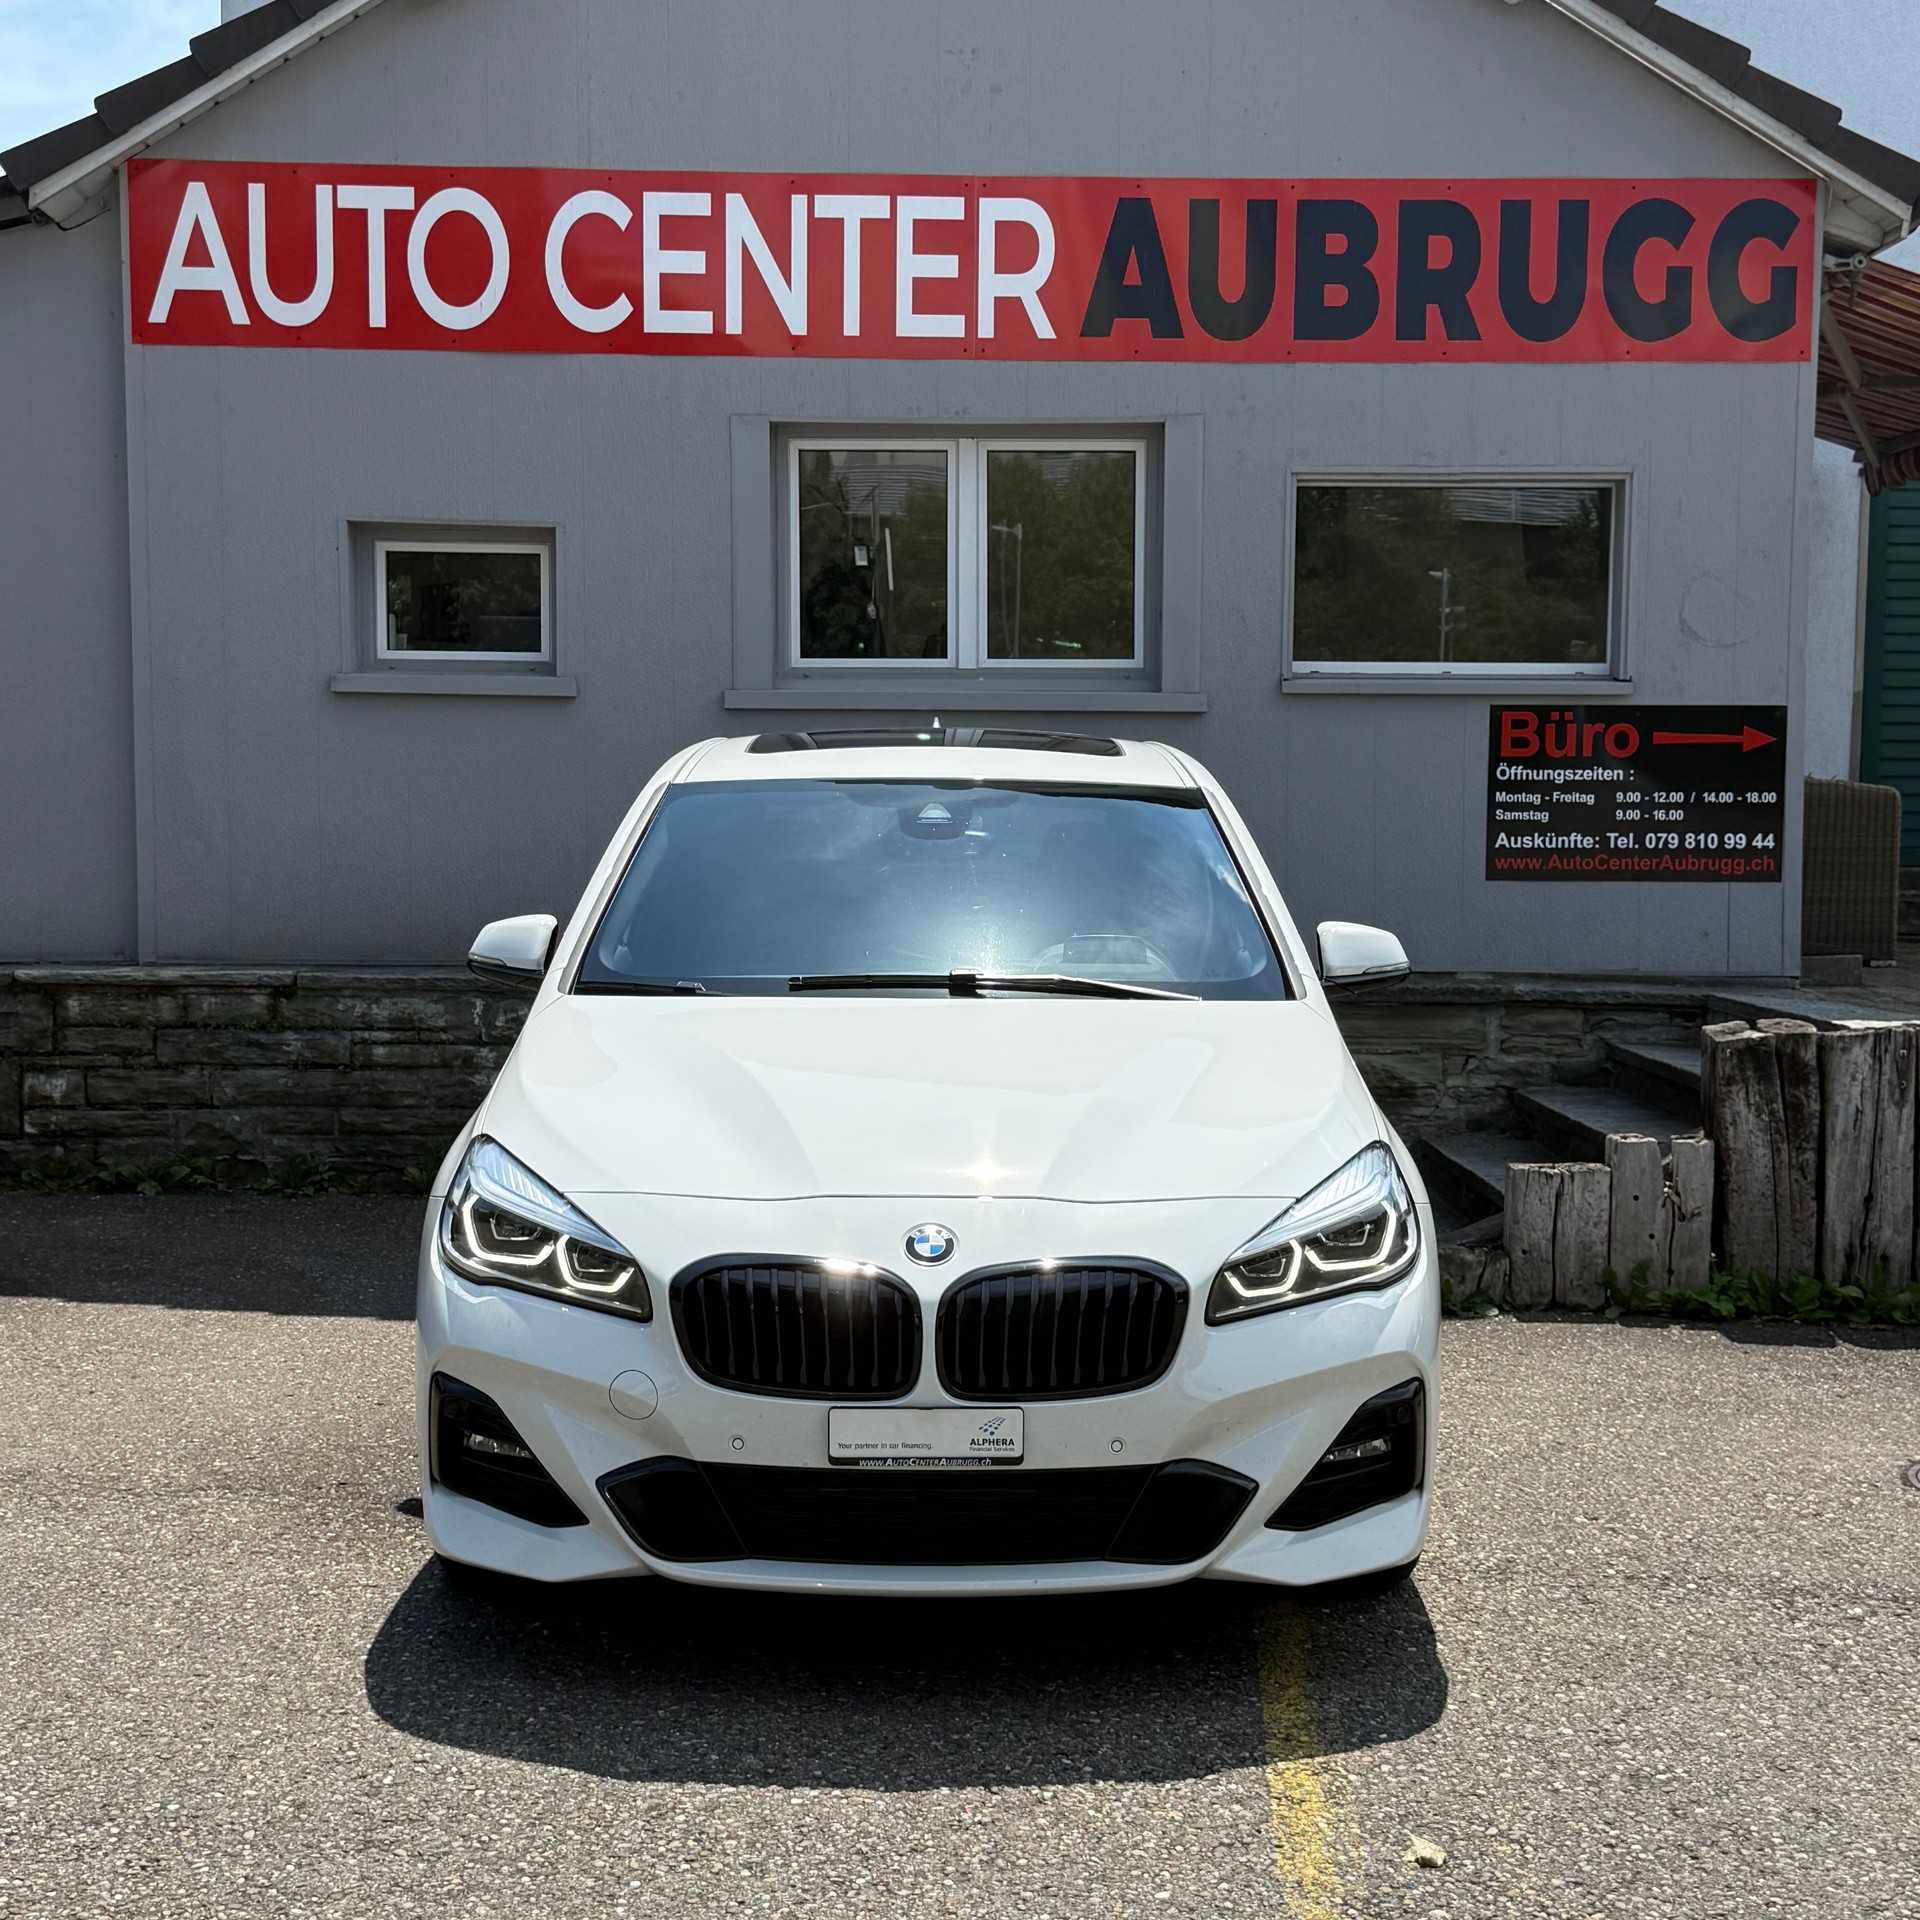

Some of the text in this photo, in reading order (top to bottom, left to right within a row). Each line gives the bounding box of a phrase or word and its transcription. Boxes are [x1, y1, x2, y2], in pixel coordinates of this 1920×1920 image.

[147, 181, 1801, 343] AUTO CENTER AUBRUGG
[1500, 711, 1640, 759] Büro
[1496, 763, 1624, 783] Öffnungszeiten
[1495, 791, 1541, 805] Montag
[1552, 791, 1595, 805] Freitag
[1616, 791, 1641, 803] 9.00
[1652, 791, 1684, 803] 12.00
[1702, 792, 1734, 803] 14.00
[1745, 792, 1777, 804] 18.00
[1495, 809, 1549, 822] Samstag
[1615, 810, 1641, 821] 9.00
[1652, 810, 1684, 821] 16.00
[1495, 832, 1775, 849] Auskünfte: Tel. 079 810 99 44
[1495, 855, 1775, 875] www.AutoCenterAubrugg.ch
[854, 1442, 879, 1450] partner
[969, 1438, 1015, 1446] ALPHERA
